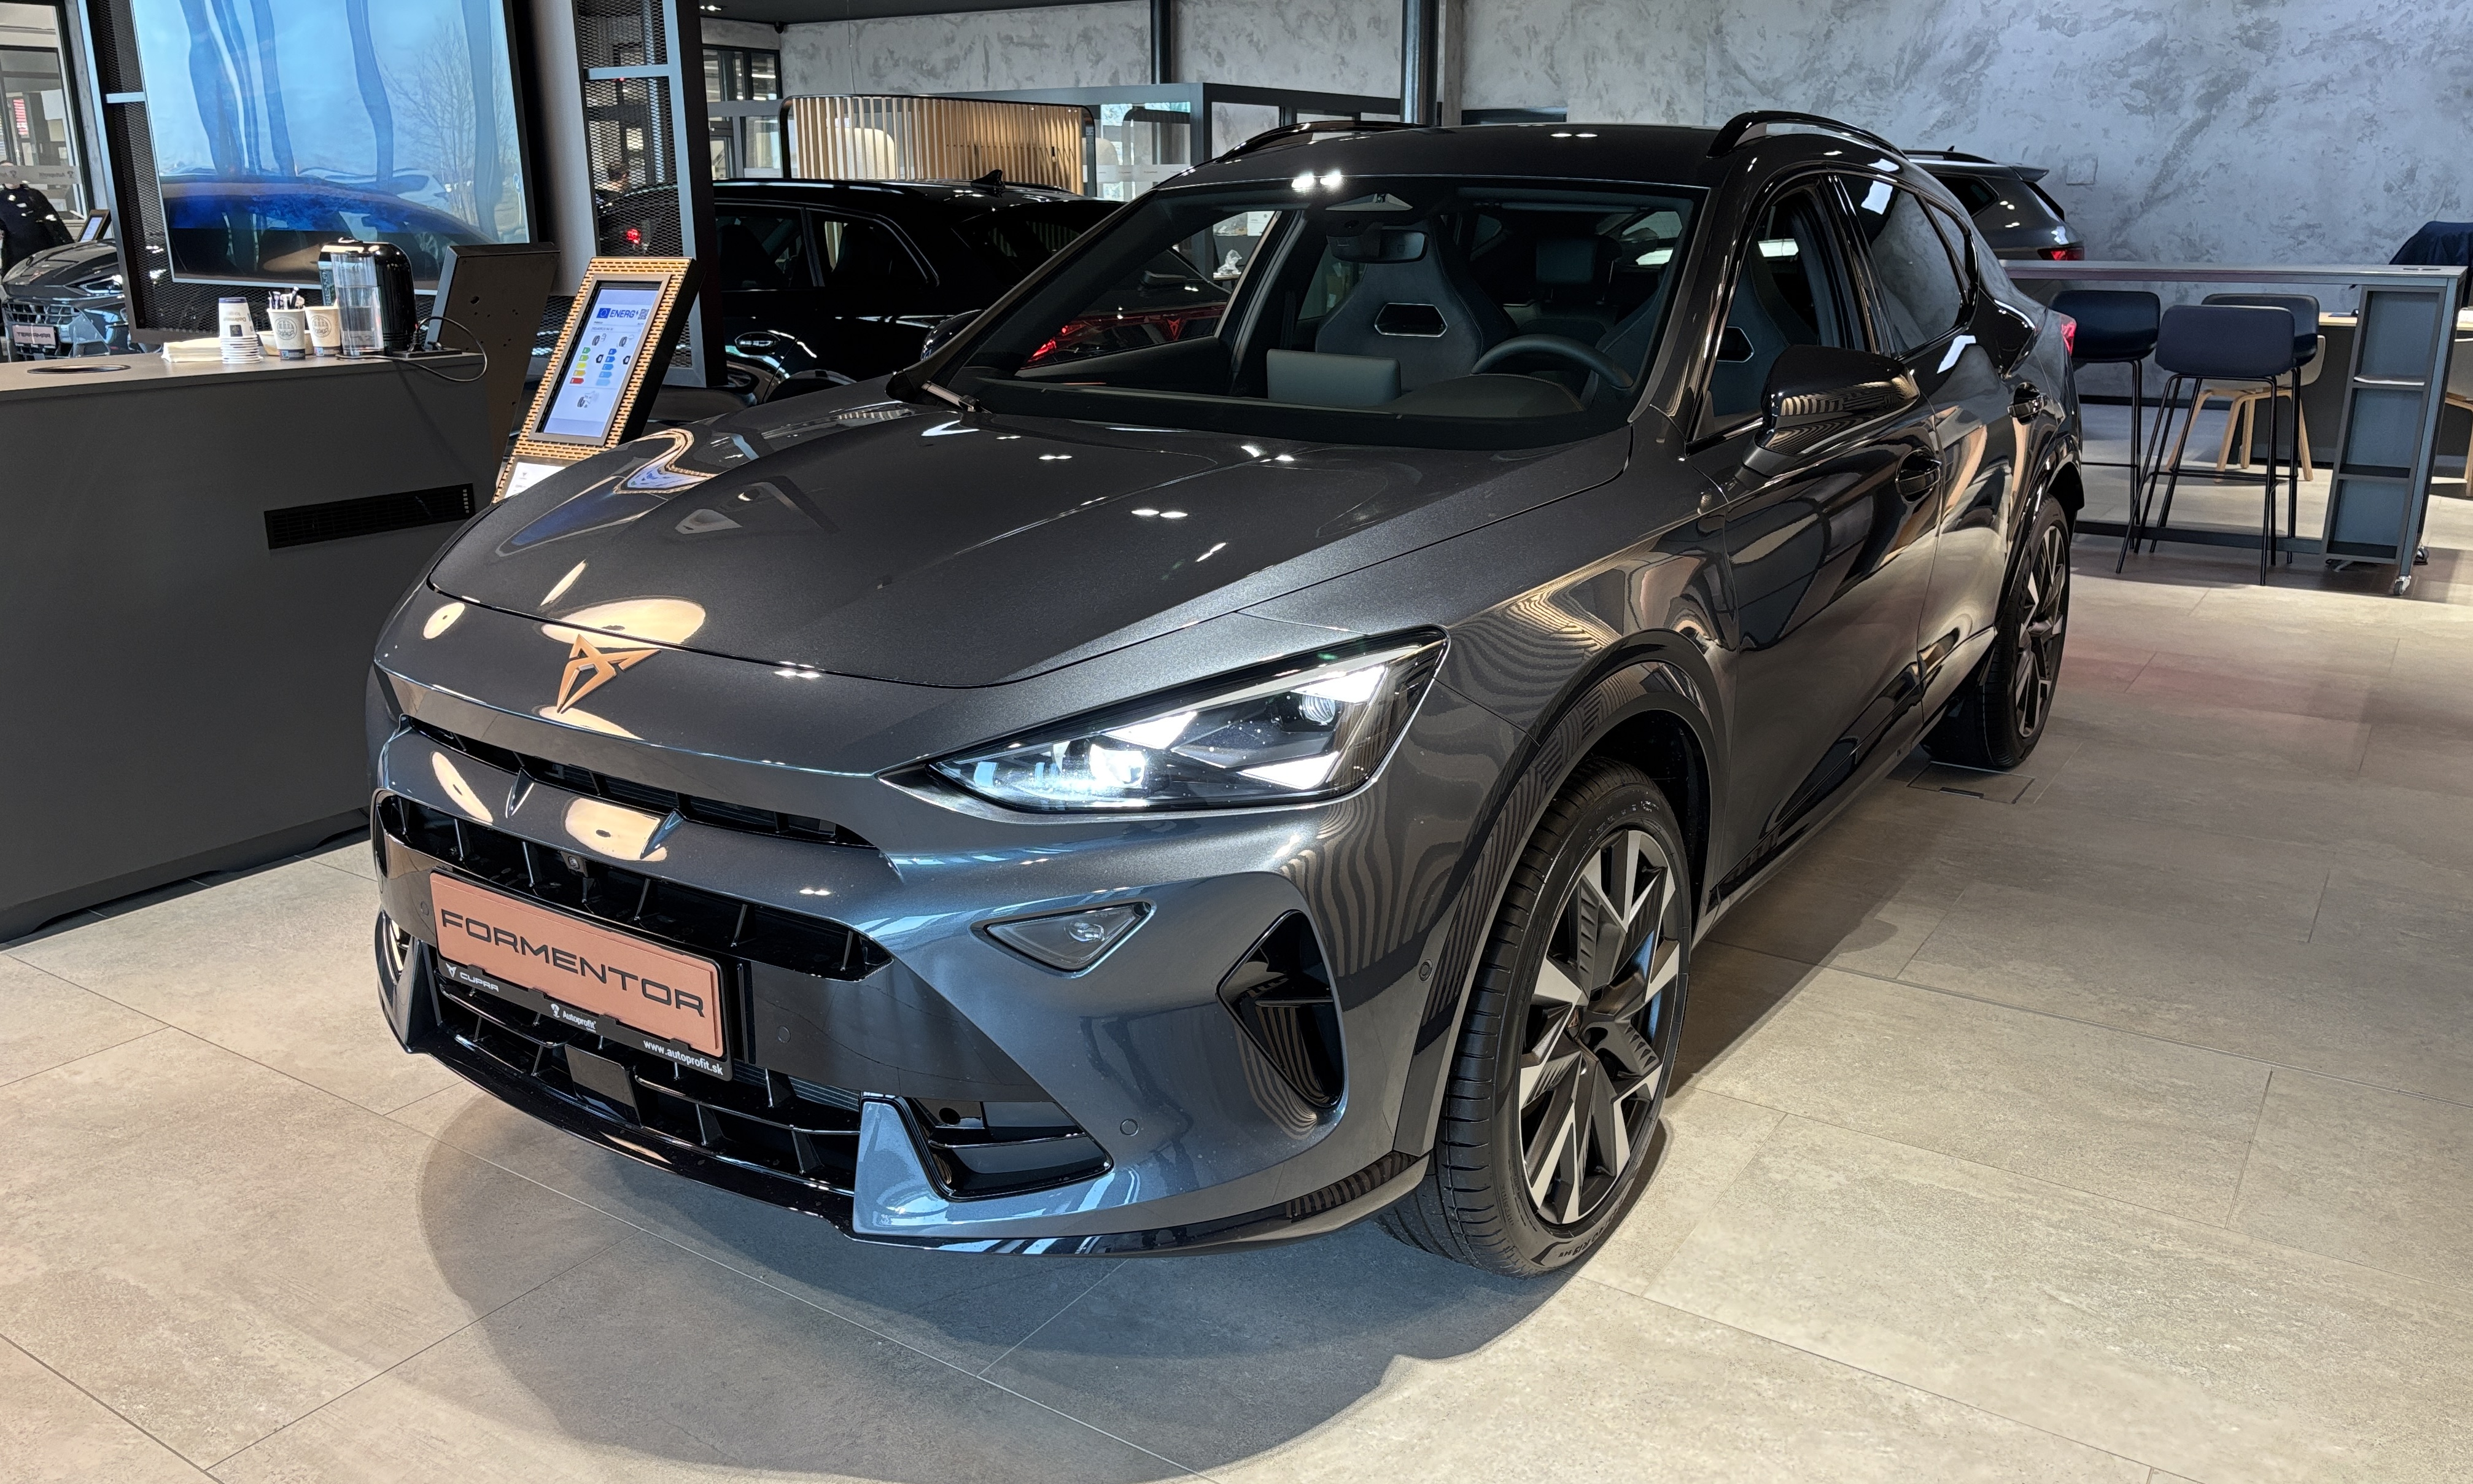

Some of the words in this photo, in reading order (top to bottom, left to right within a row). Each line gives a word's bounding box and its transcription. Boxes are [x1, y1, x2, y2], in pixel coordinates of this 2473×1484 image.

[610, 309, 635, 318] ENERG
[441, 909, 705, 1017] FORMENTOR
[460, 972, 499, 992] CUPRA
[643, 1040, 724, 1075] www.autoprofit.sk
